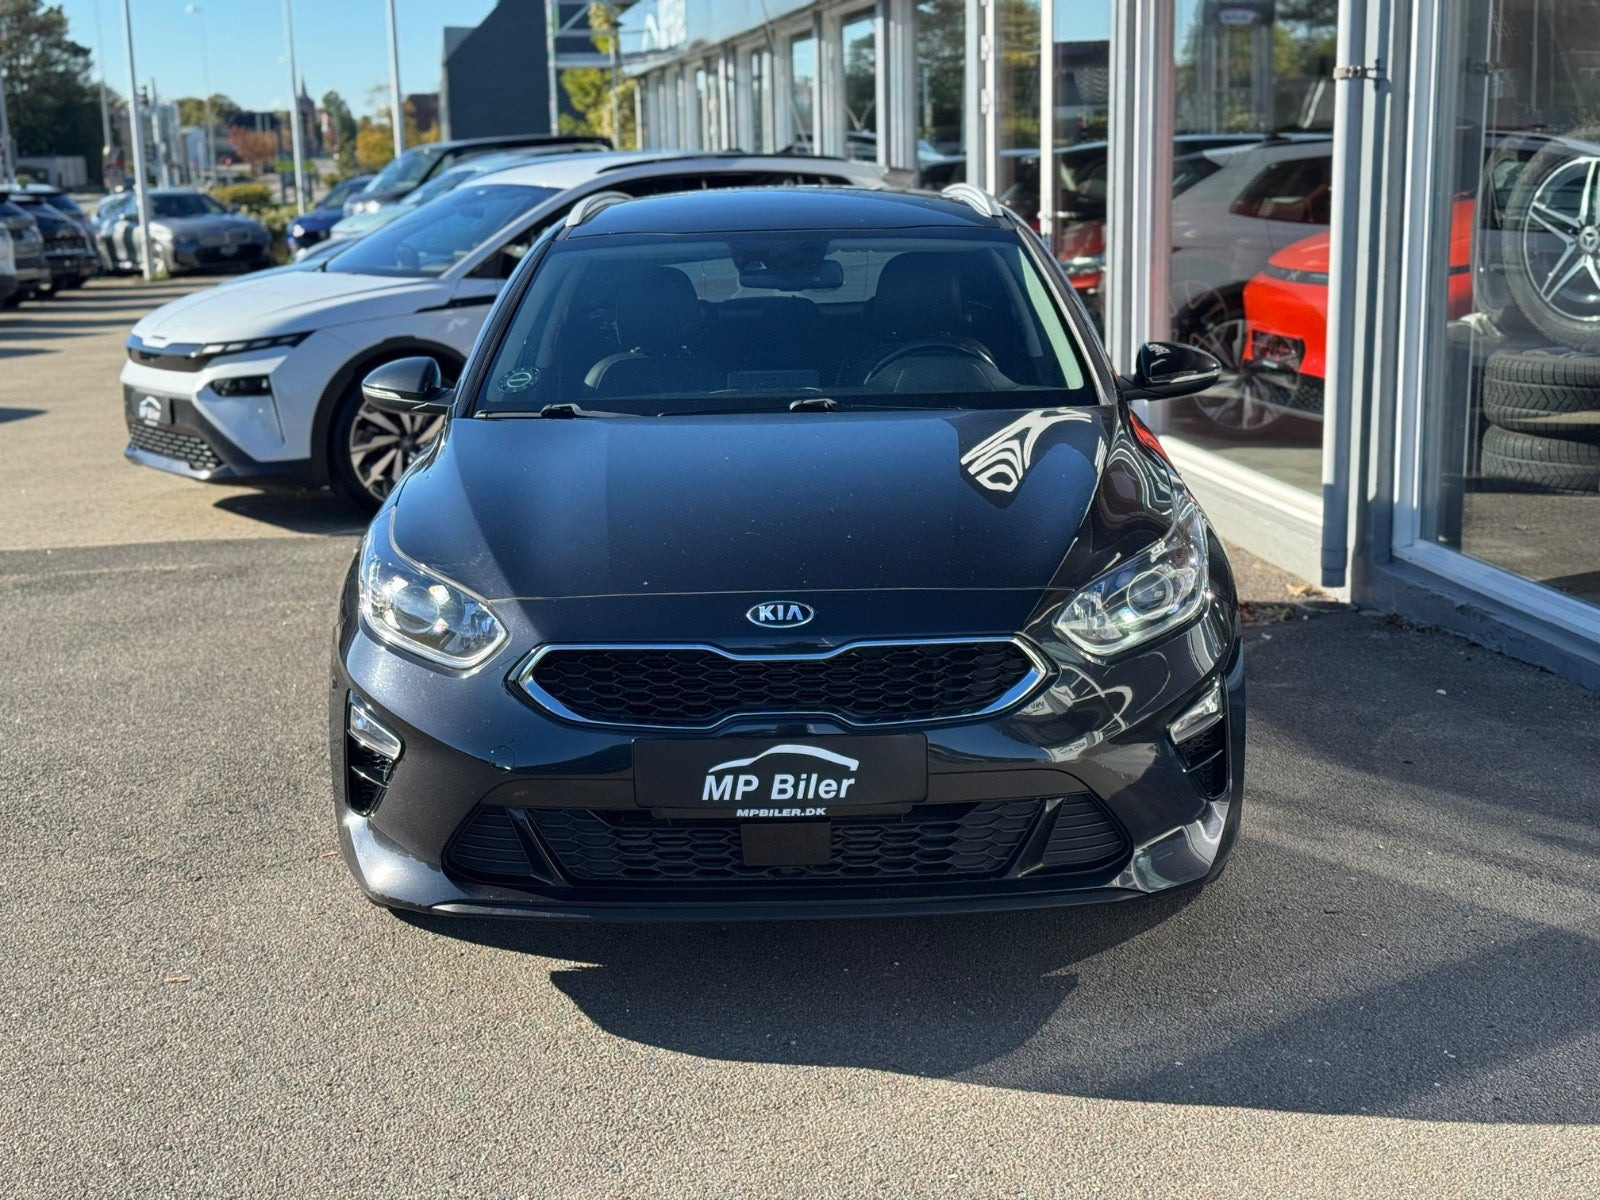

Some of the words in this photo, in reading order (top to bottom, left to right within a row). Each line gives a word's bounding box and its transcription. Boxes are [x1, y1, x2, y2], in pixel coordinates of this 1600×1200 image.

[758, 604, 804, 621] KIA
[702, 774, 760, 801] MP
[770, 773, 856, 800] Biler
[736, 807, 827, 817] MPBILER.DK
